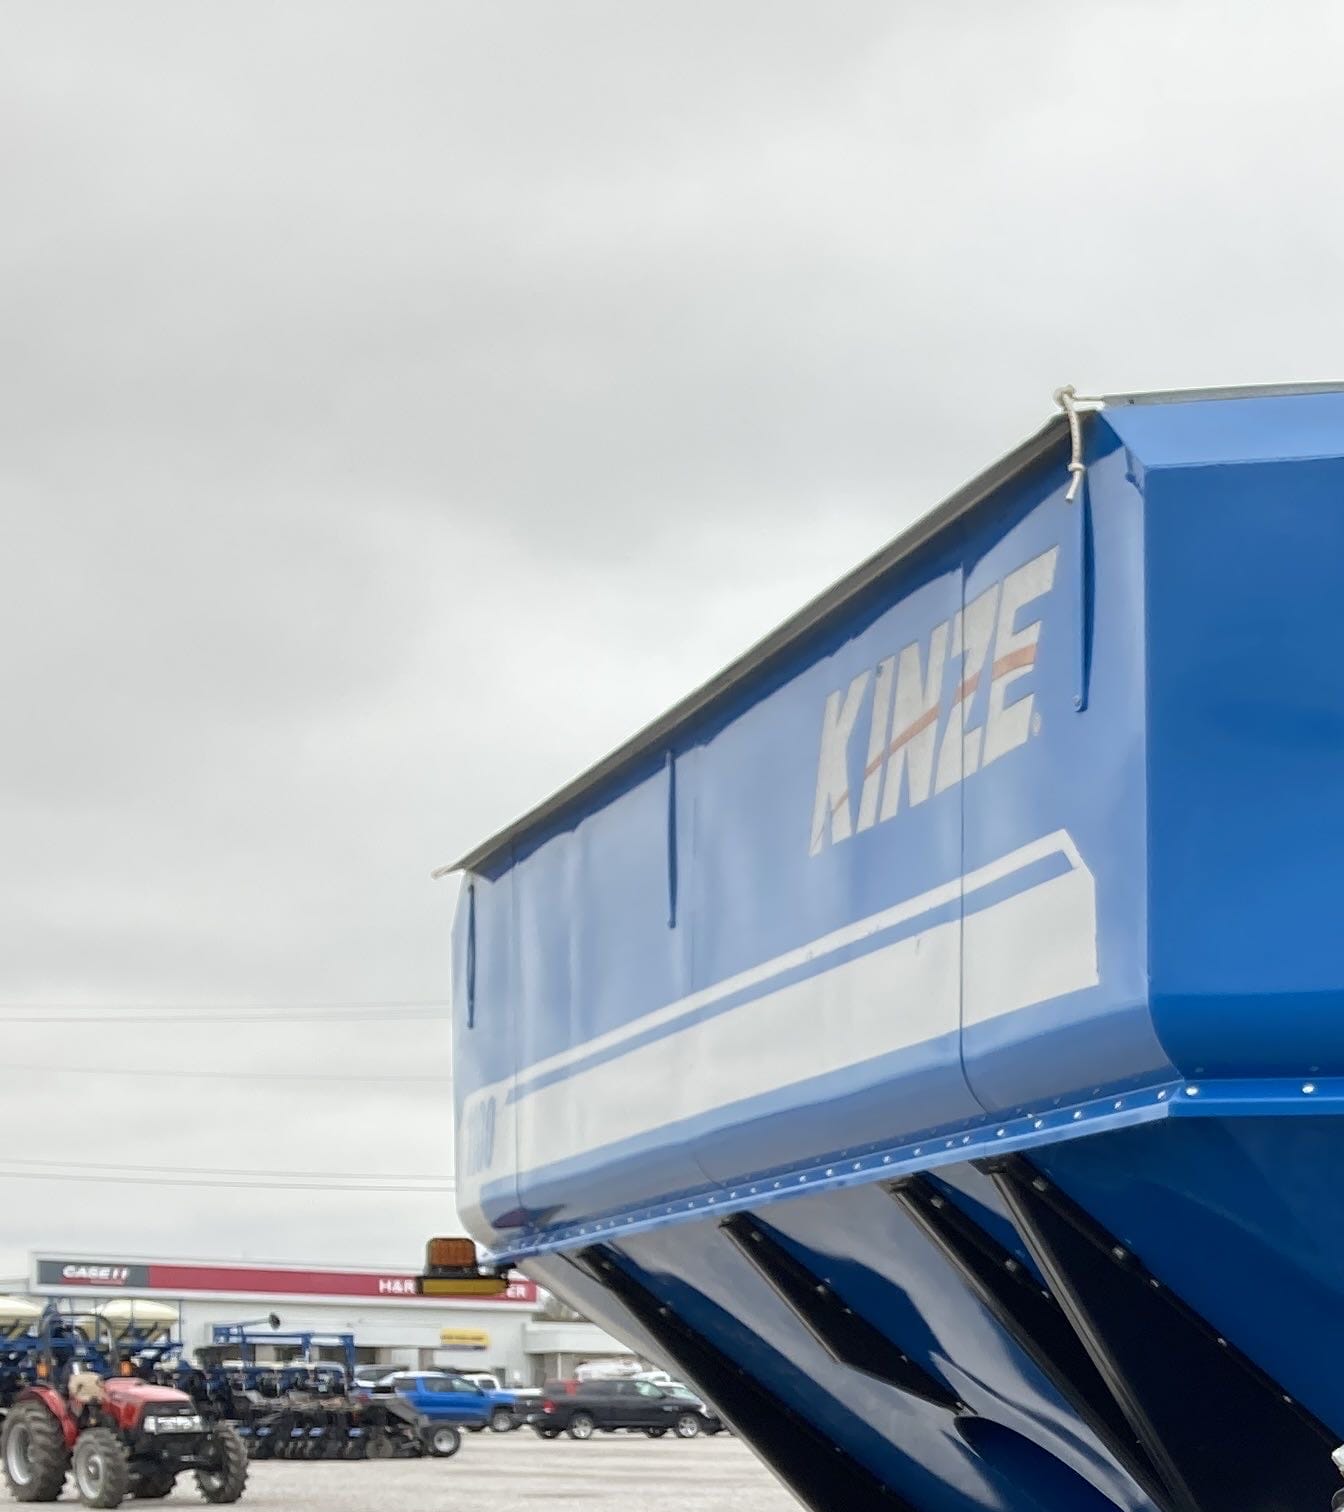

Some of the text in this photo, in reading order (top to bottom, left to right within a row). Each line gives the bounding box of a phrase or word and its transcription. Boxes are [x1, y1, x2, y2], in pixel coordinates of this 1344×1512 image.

[807, 544, 1060, 858] KINZE
[62, 1264, 111, 1279] CASE
[378, 1279, 416, 1294] H&R
